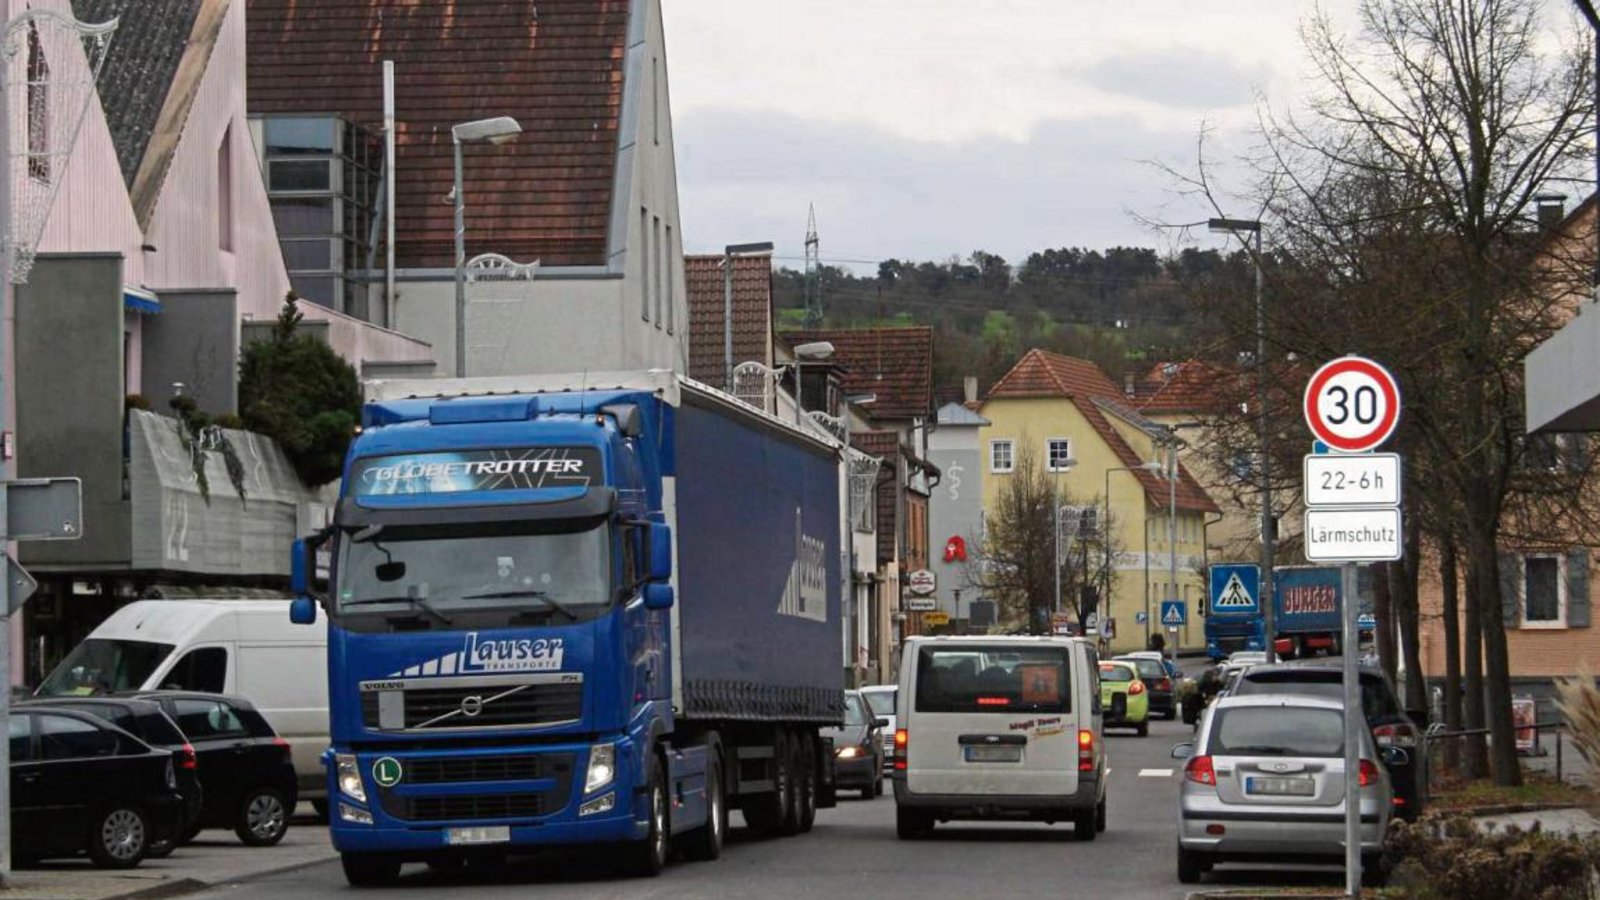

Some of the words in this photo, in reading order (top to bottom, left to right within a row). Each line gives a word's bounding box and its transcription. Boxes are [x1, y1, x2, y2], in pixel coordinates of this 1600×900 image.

[1326, 385, 1377, 424] 30
[374, 459, 584, 481] GLOBETROTTER
[1311, 527, 1395, 543] Lärmschutz
[462, 632, 564, 671] Lauser
[485, 660, 557, 670] TRANSPORTE
[364, 682, 405, 690] VOLVO
[380, 763, 394, 781] L
